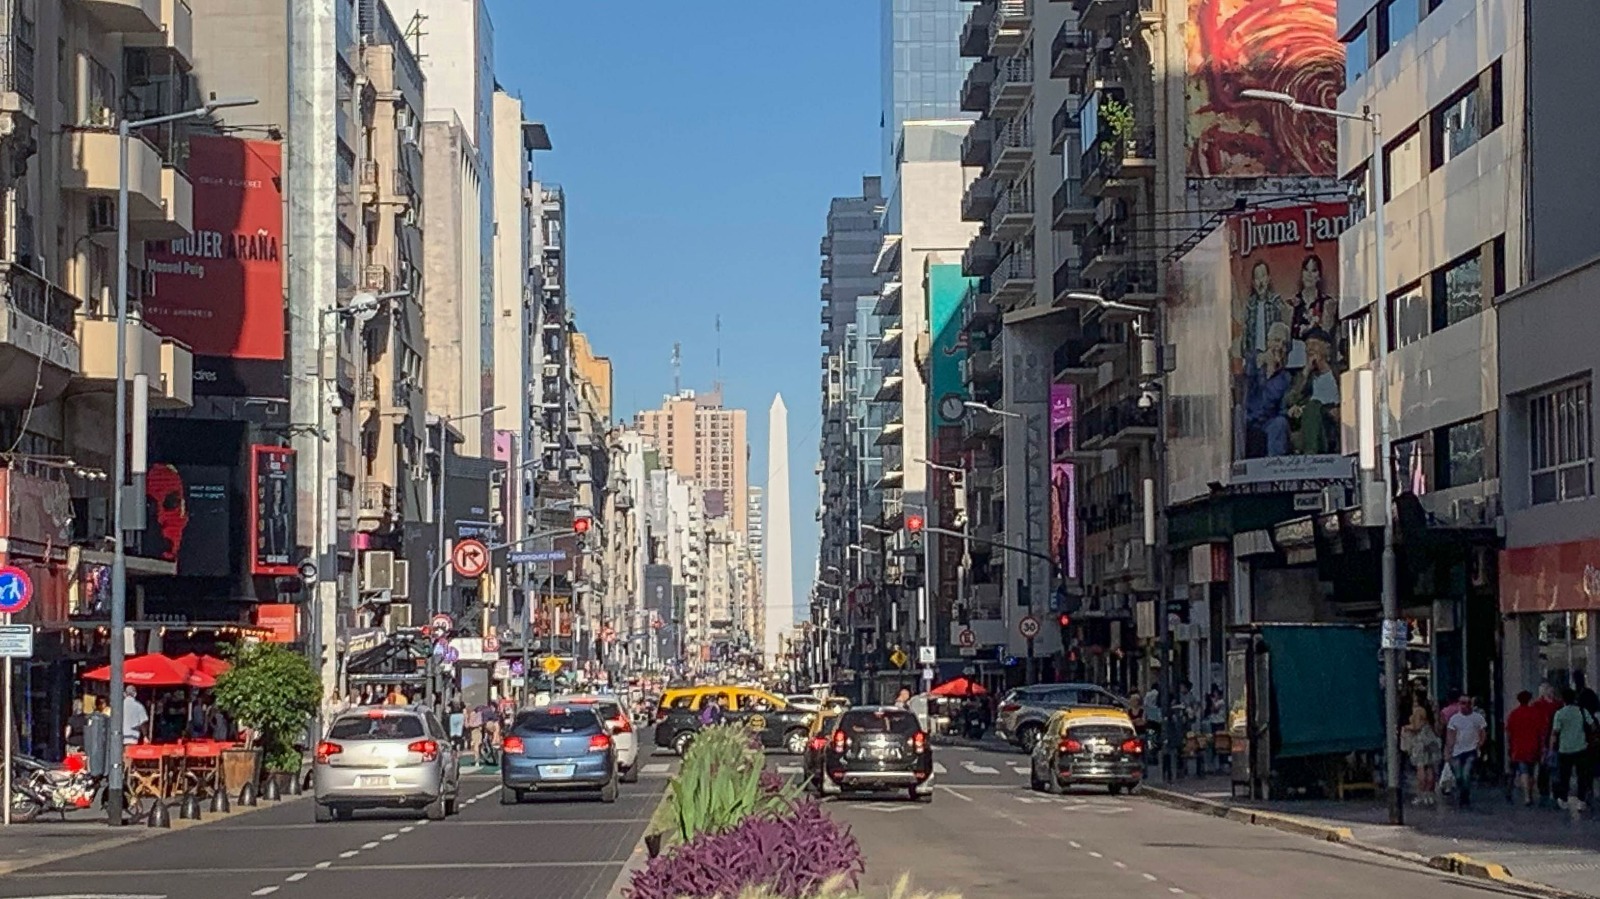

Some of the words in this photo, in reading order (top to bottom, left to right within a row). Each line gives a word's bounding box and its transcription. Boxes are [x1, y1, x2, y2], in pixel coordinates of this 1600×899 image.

[171, 229, 223, 259] MUJER
[227, 228, 278, 262] ARAÑA
[1240, 213, 1300, 256] Divina
[147, 259, 182, 275] Manuel
[183, 261, 205, 279] Puig
[1024, 622, 1036, 632] 30
